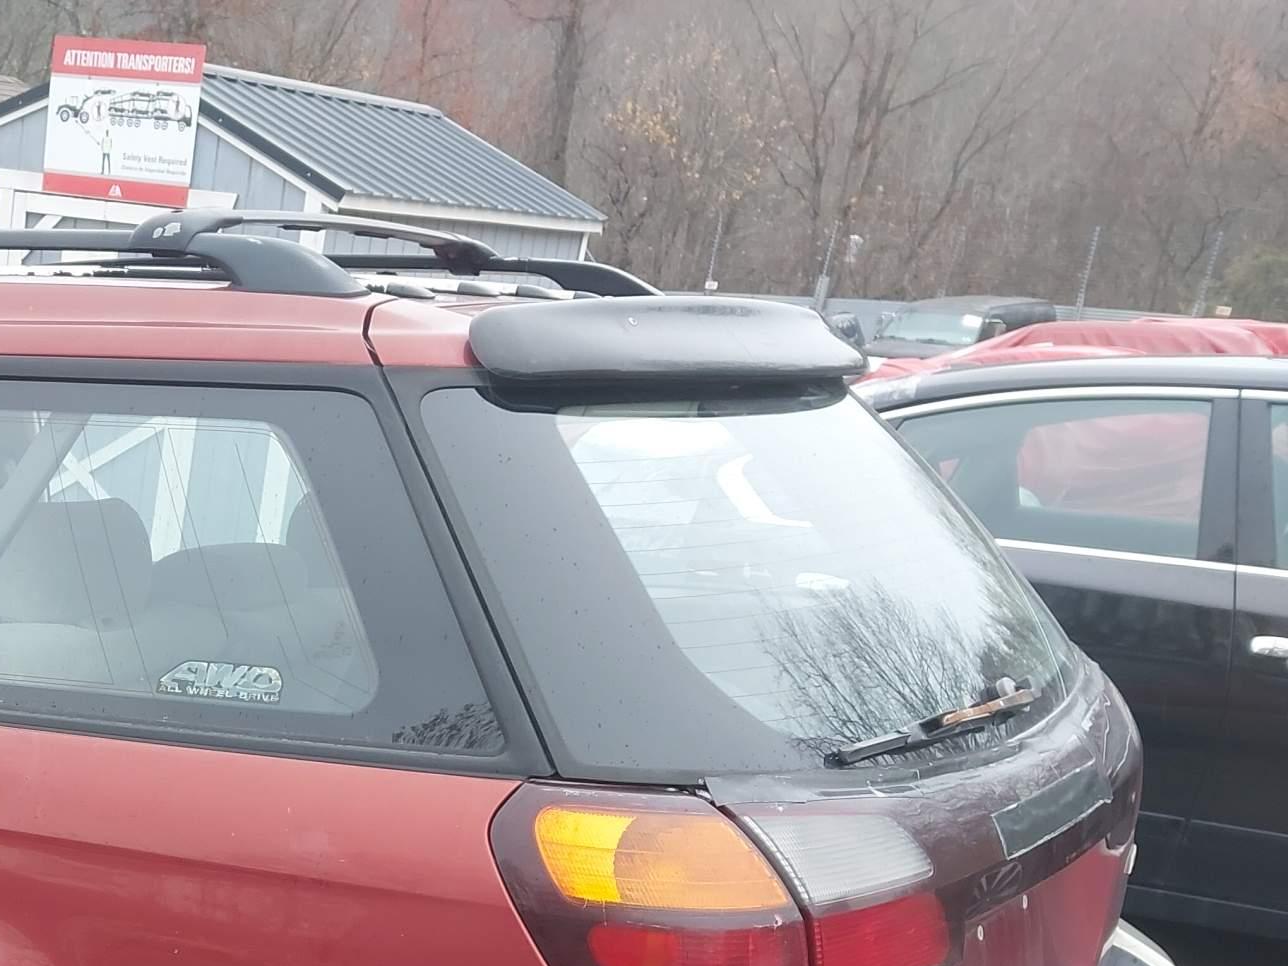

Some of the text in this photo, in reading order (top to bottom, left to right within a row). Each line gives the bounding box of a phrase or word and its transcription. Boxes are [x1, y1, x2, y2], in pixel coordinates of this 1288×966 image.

[63, 49, 196, 74] ATTENTION TRANSPORTERS!
[160, 661, 282, 693] AWD
